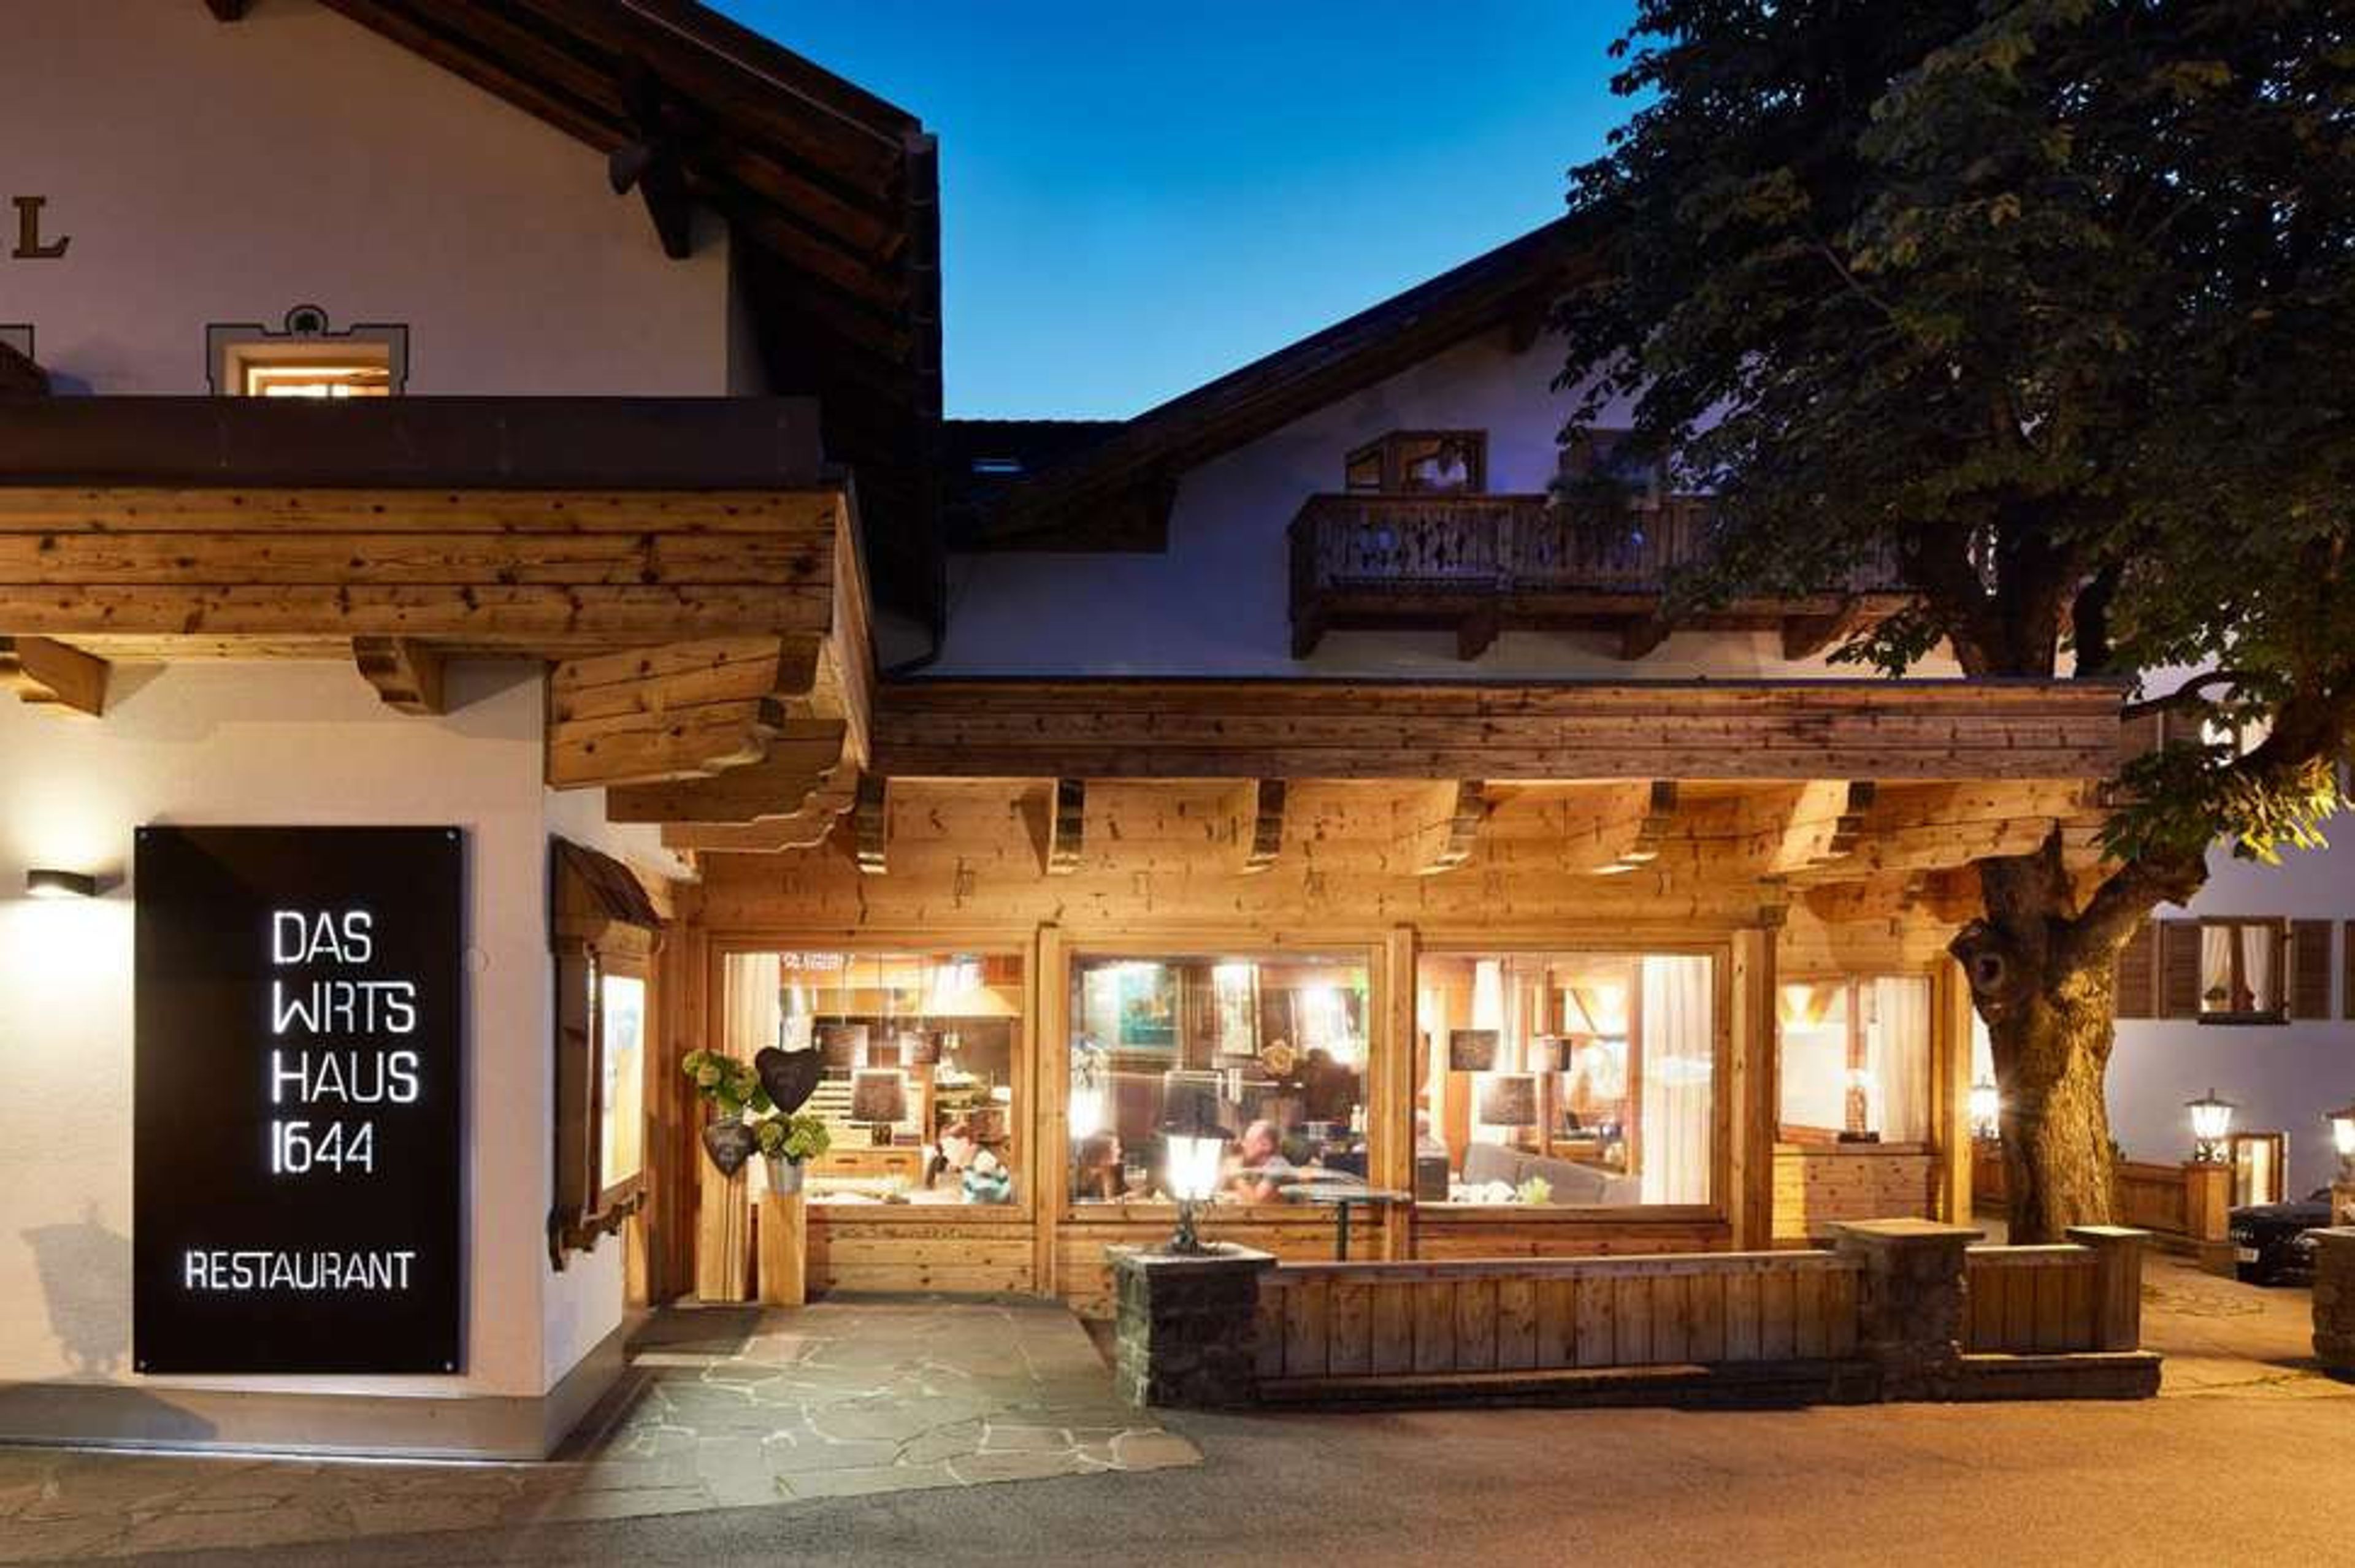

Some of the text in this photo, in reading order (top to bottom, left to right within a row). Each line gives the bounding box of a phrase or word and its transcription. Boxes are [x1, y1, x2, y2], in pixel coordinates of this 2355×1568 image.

[12, 196, 71, 259] L
[272, 911, 372, 965] DAS
[272, 980, 415, 1034] WIRTS
[272, 1049, 419, 1104] HAUS
[272, 1120, 372, 1174] 1644
[185, 1250, 415, 1290] RESTAURANT
